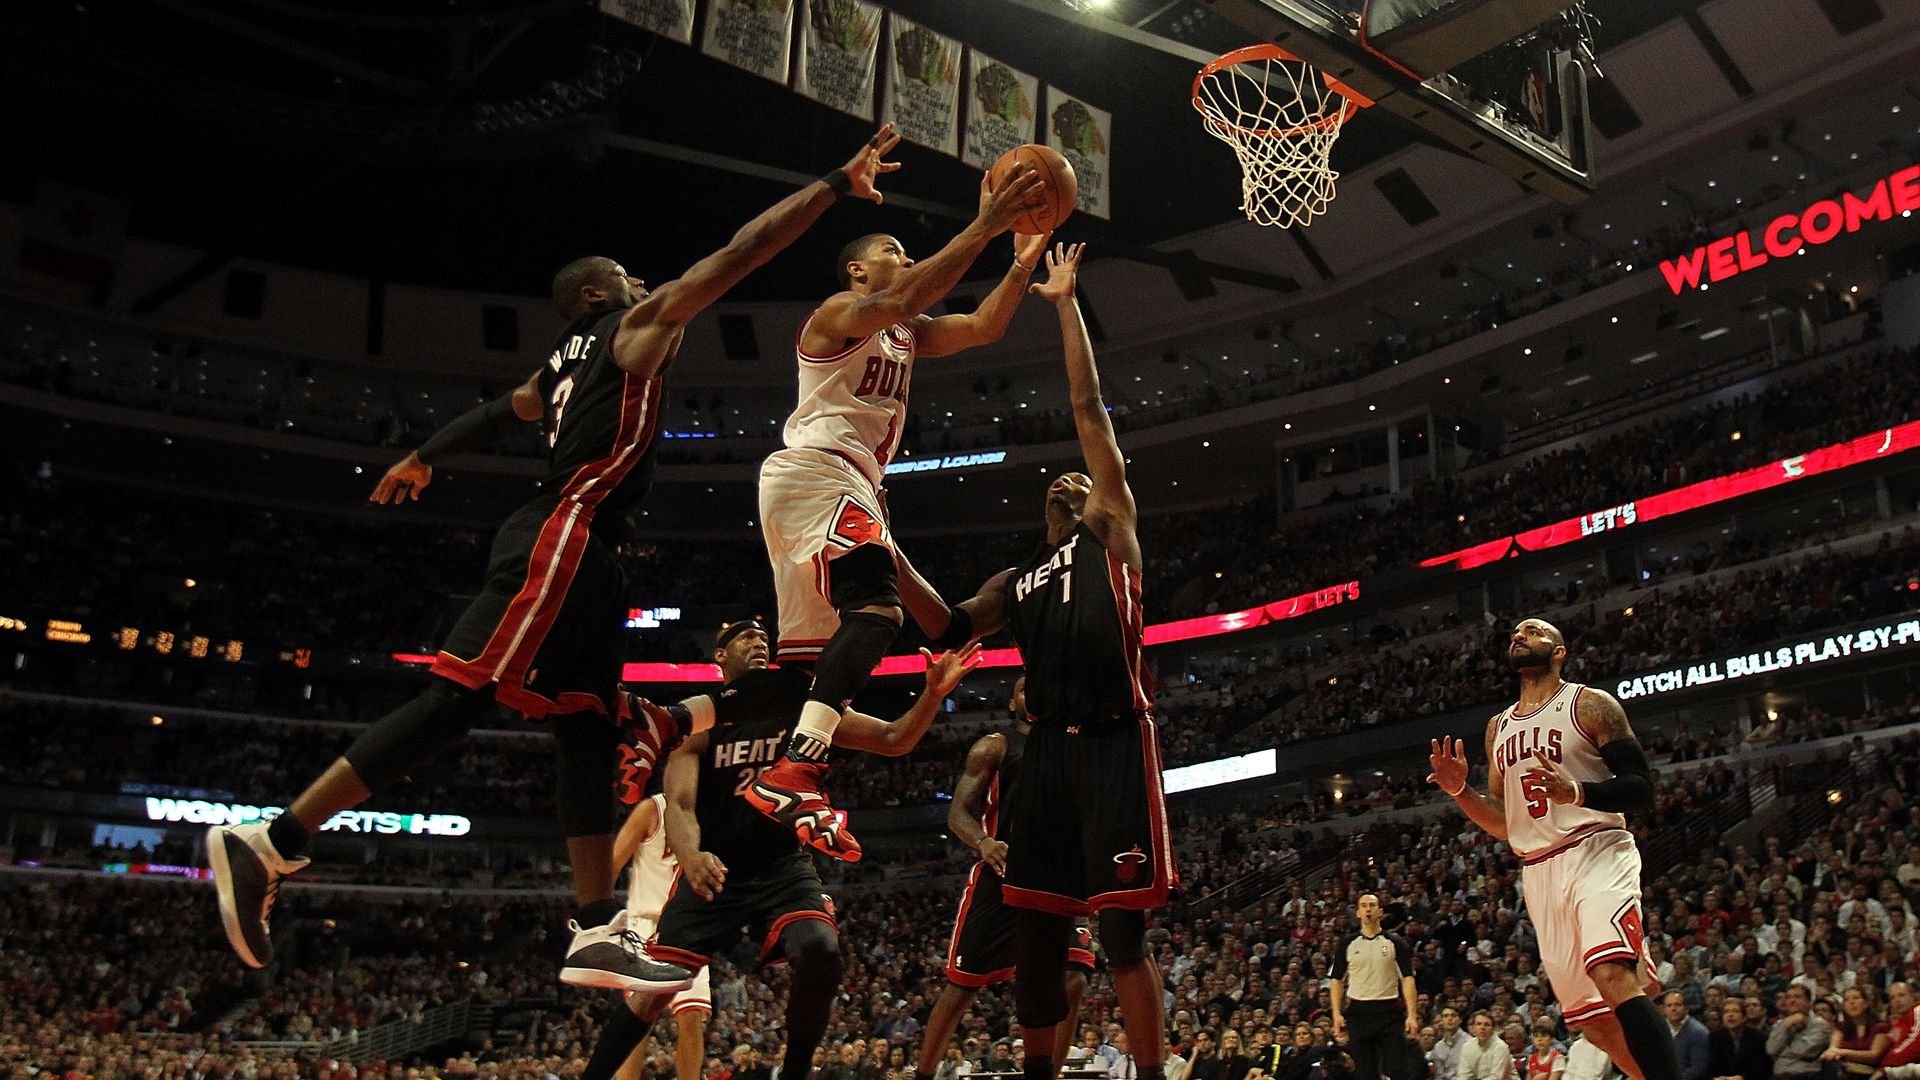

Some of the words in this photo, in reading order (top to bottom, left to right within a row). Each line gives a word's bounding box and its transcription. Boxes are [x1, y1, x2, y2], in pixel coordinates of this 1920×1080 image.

[1658, 164, 1920, 296] WELCOME
[873, 413, 898, 466] 1
[942, 452, 1007, 469] LOUNGE
[1580, 501, 1637, 537] LET'S
[1015, 533, 1080, 603] HEAT
[1059, 570, 1073, 604] 1
[1315, 579, 1360, 609] LET'S
[1616, 668, 1683, 700] CATCH
[1685, 661, 1726, 688] ALL
[1726, 646, 1794, 679] BULLS
[713, 728, 788, 769] HEAT
[1496, 727, 1563, 778] BULLS
[1520, 772, 1549, 820] 5
